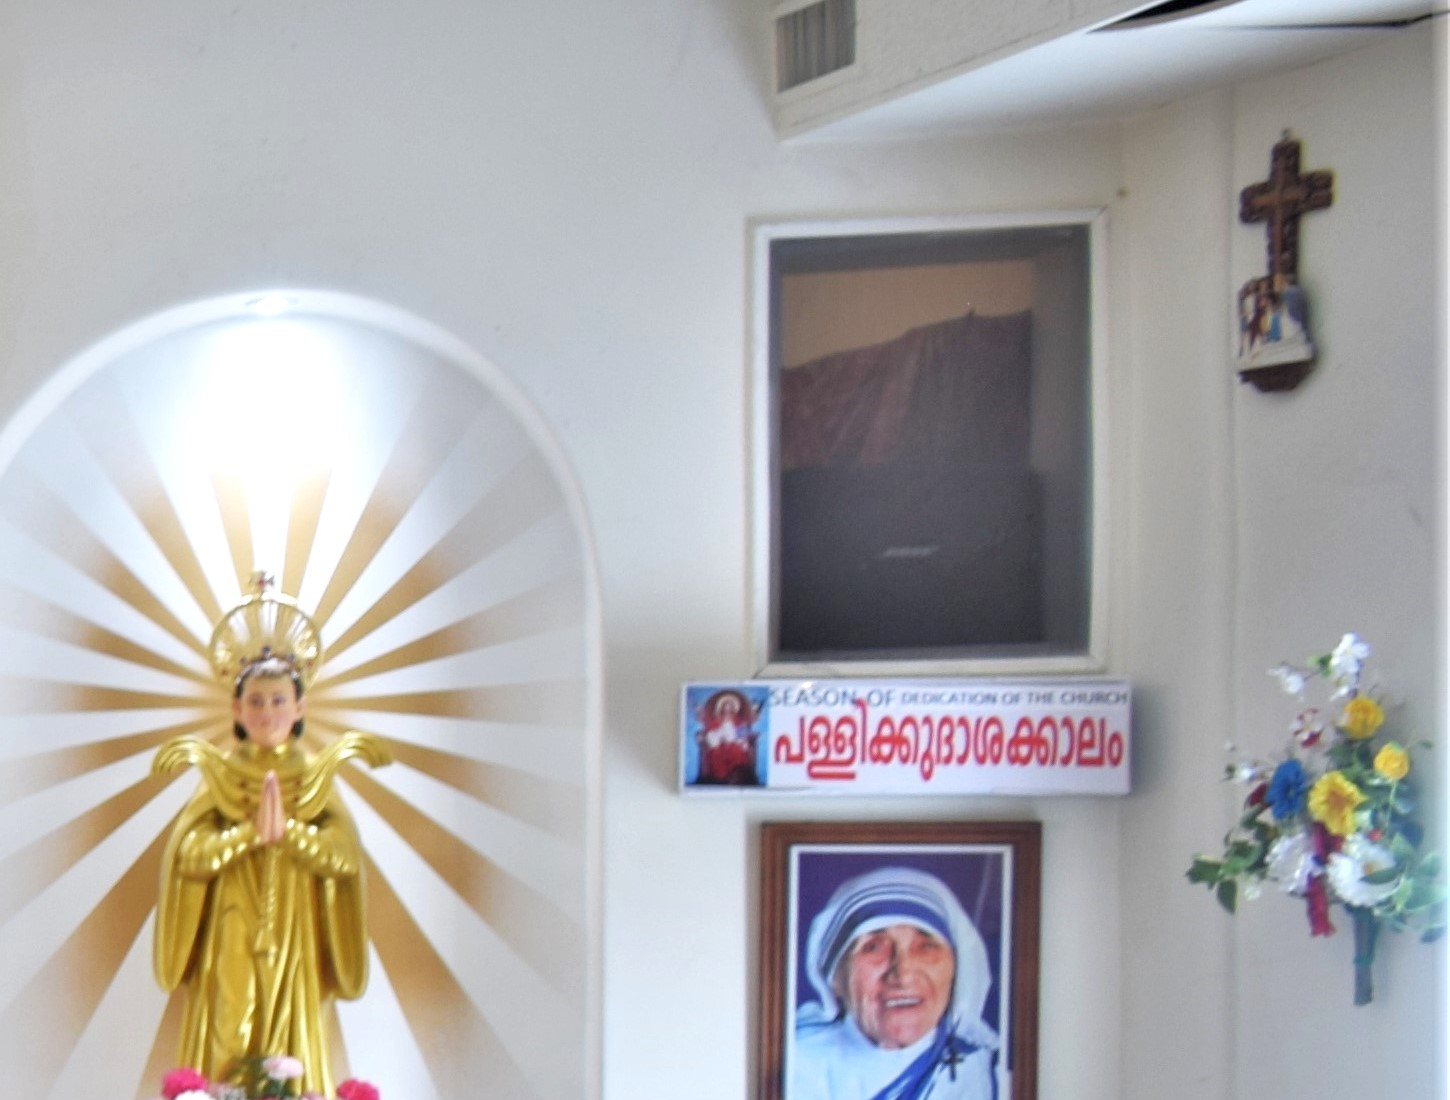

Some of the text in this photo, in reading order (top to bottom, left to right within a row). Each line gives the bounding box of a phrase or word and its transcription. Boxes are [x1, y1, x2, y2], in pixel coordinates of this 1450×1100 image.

[770, 687, 1129, 707] SEASON OF DEDICATION OF THE CHURCH
